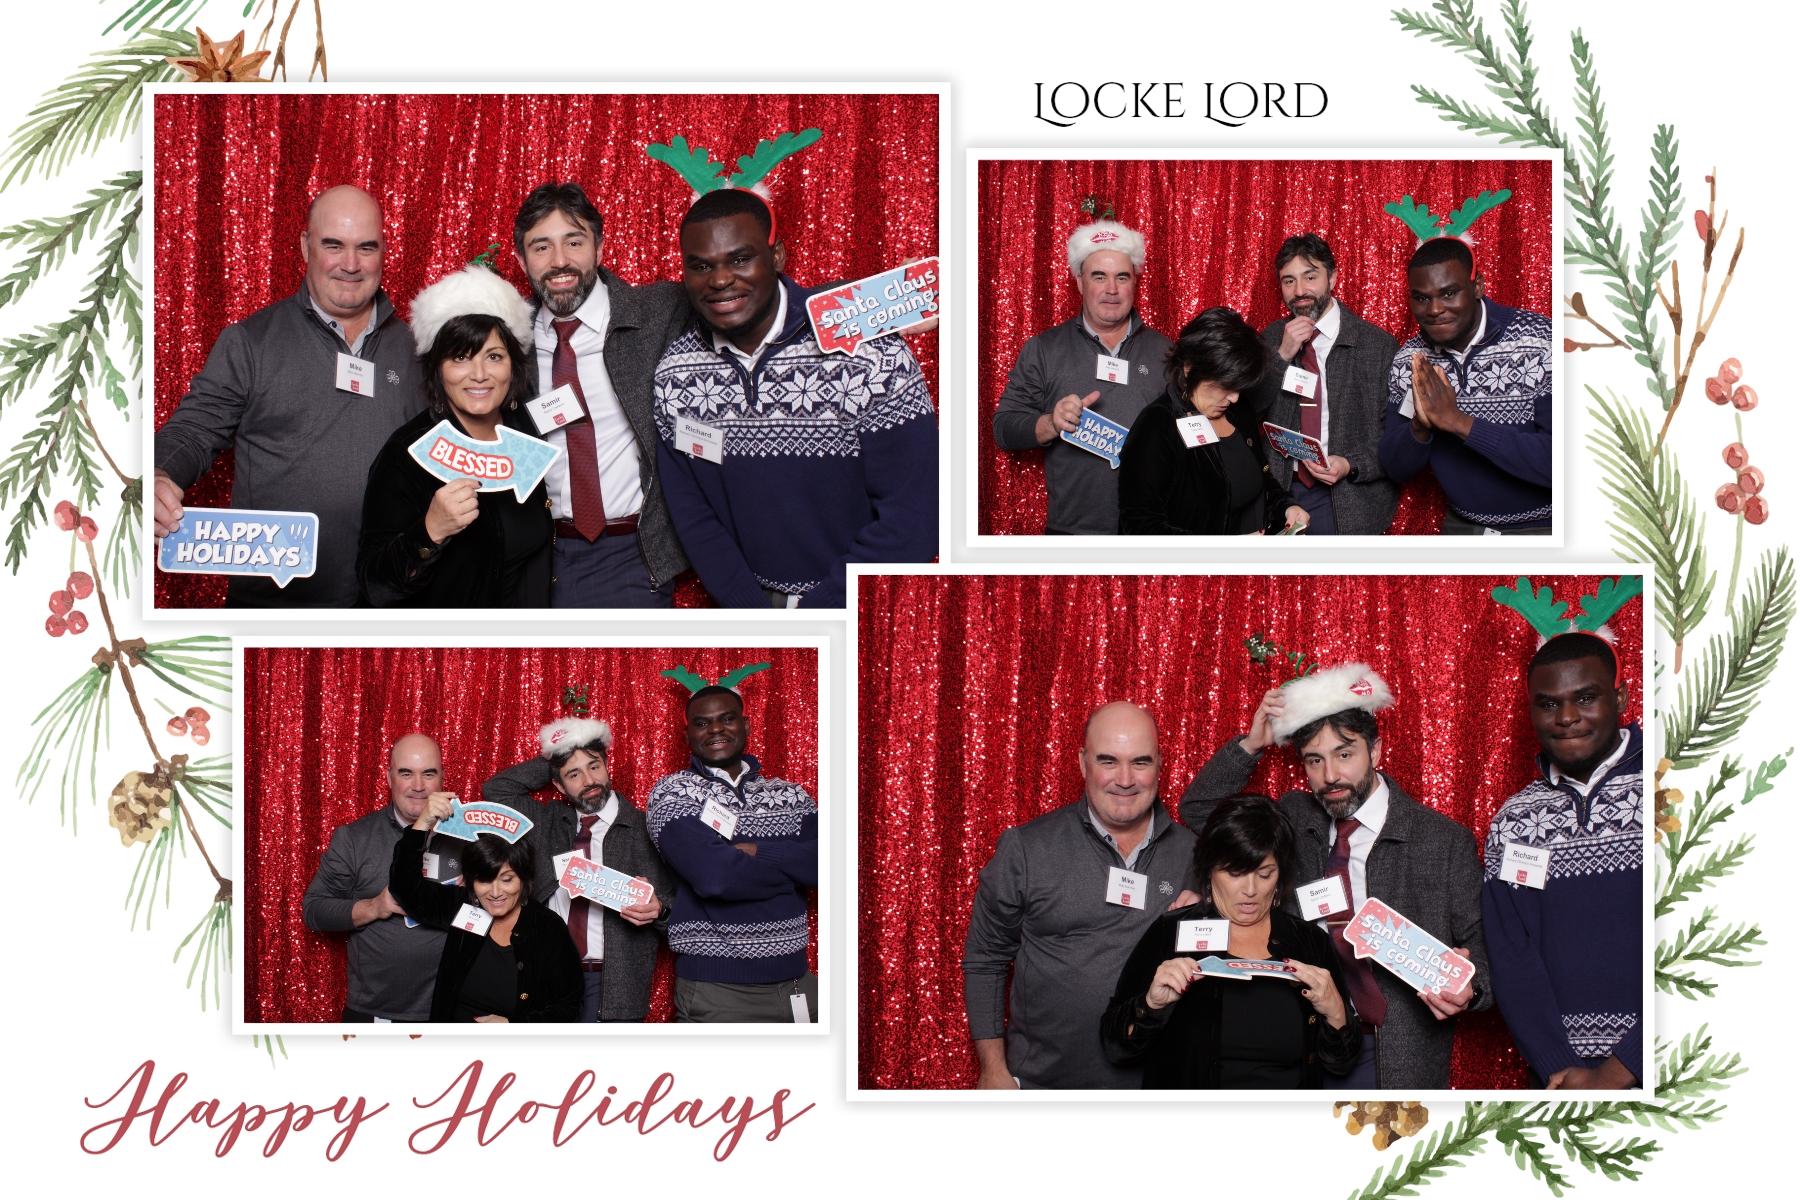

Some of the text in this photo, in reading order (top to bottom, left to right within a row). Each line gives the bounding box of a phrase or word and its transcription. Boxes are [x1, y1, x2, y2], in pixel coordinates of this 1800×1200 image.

[821, 269, 937, 329] Santa Claus
[842, 287, 938, 339] is coming
[541, 396, 560, 409] Samir
[685, 424, 712, 438] Richard
[1084, 418, 1124, 444] HAPPY
[1270, 432, 1319, 452] Santa Claus
[432, 439, 512, 478] BLESSED
[1289, 446, 1321, 465] coming
[195, 520, 281, 544] HAPPY
[177, 542, 301, 567] HOLIDAYS
[464, 811, 519, 833] BLESSED
[711, 805, 730, 820] Richard
[1512, 850, 1539, 861] Richard
[570, 866, 645, 898] Santa Claus
[576, 879, 587, 890] is
[1310, 886, 1329, 897] Samir
[1361, 914, 1463, 979] Santa Claus
[1366, 934, 1450, 995] is coming
